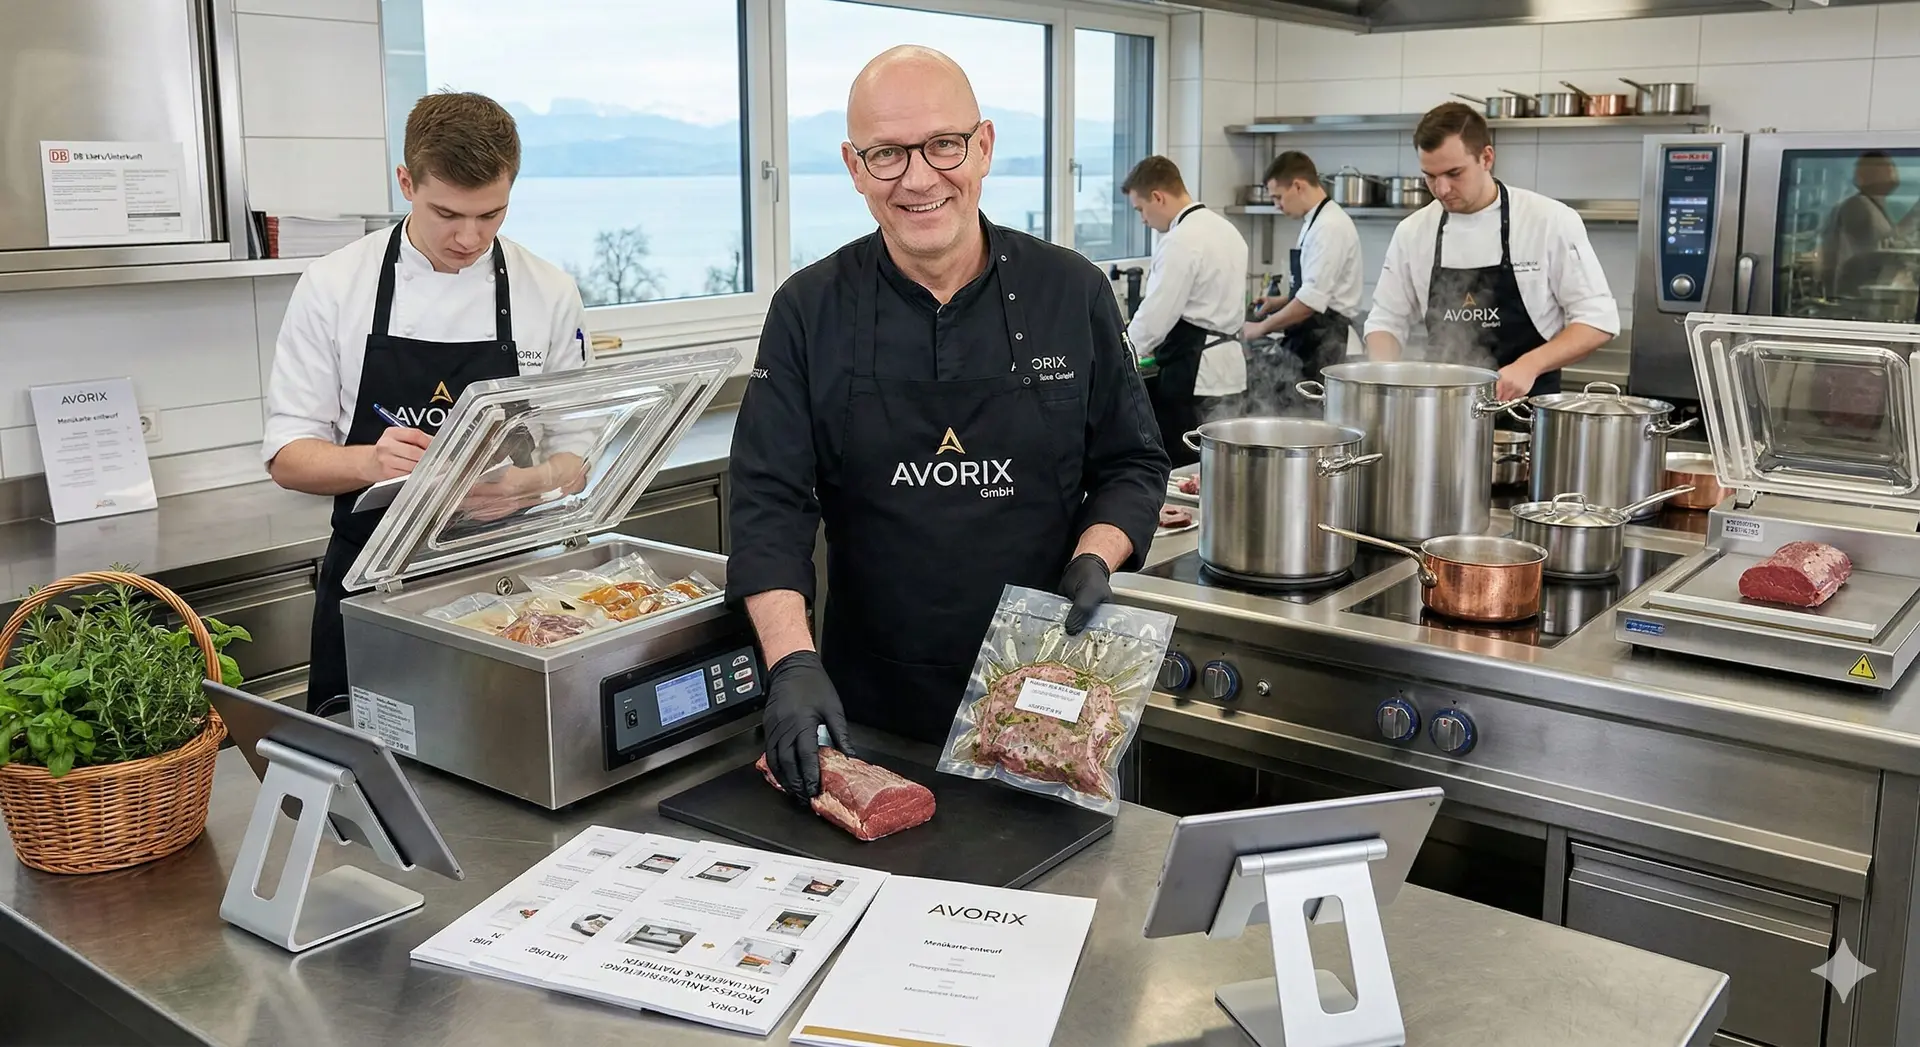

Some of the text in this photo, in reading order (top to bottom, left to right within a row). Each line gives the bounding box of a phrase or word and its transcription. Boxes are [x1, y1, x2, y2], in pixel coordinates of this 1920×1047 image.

[51, 151, 67, 161] DB
[1443, 307, 1500, 321] AVORIX
[518, 350, 542, 360] ORIX
[1031, 355, 1067, 370] ORIX
[61, 391, 108, 405] AVORIX
[396, 406, 452, 427] AVO
[890, 458, 1014, 487] AVORIX
[980, 486, 1014, 498] GmbH
[927, 903, 1028, 926] AVORIX
[684, 970, 694, 978] &
[708, 1001, 755, 1016] AVORIX
